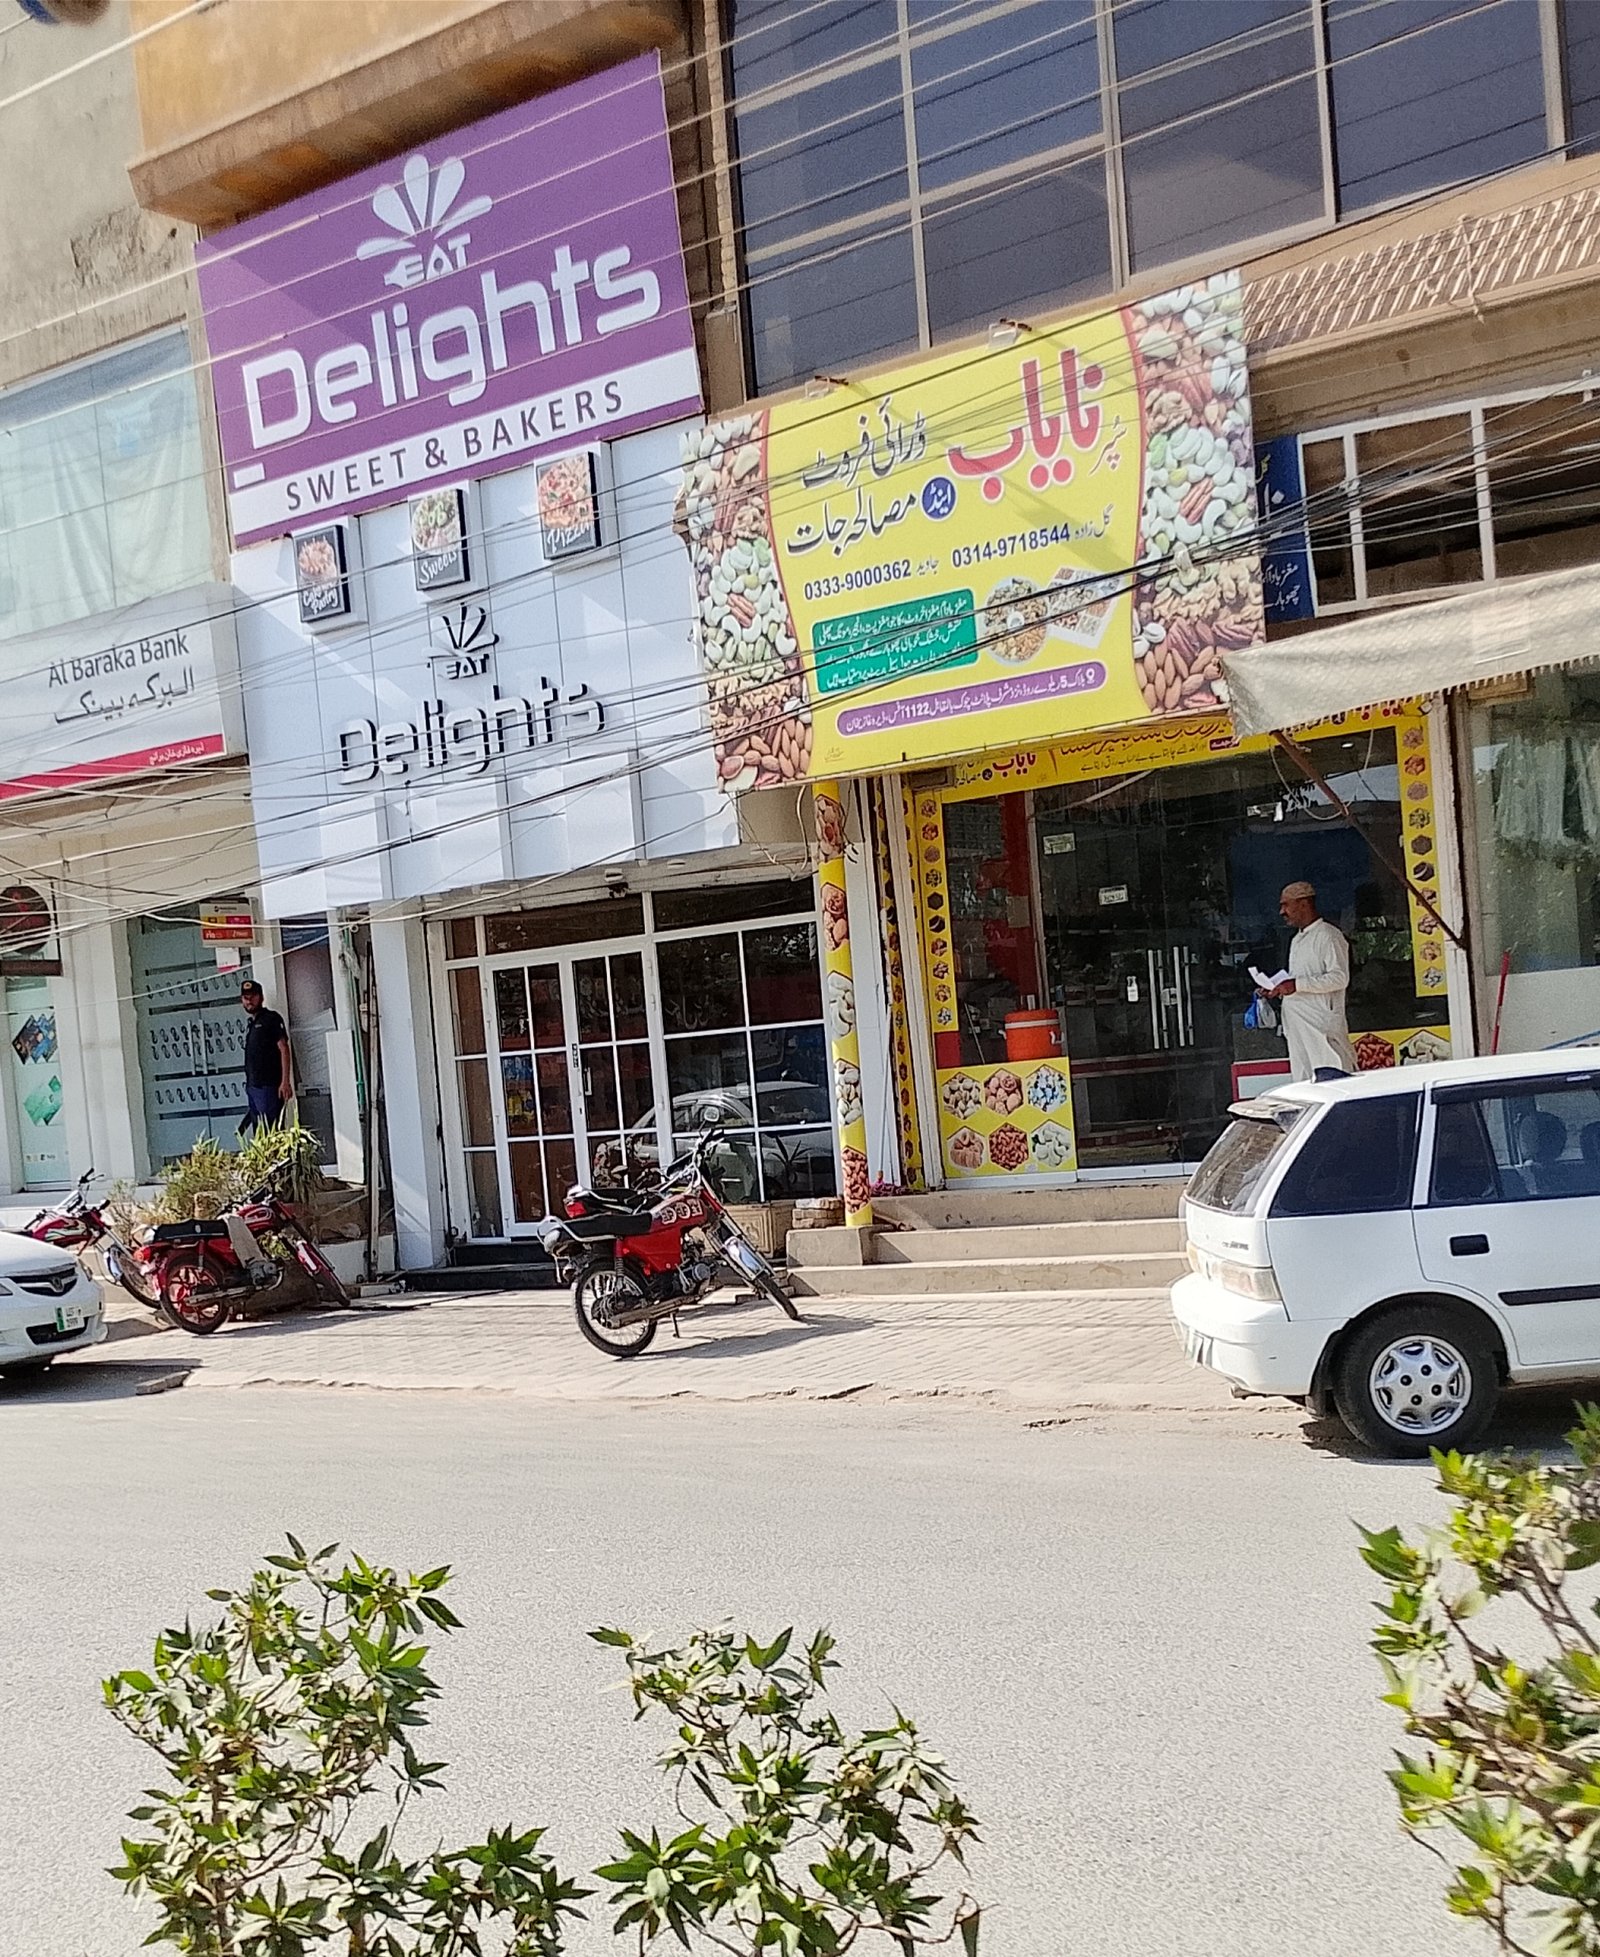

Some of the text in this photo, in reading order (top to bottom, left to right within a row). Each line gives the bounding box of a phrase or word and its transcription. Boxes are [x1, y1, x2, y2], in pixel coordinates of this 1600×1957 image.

[388, 234, 471, 288] EAT
[242, 245, 661, 449] Delights
[287, 380, 623, 511] SWEET & BAKERS
[803, 415, 870, 488] فروٹ
[948, 348, 1103, 501] نایاب
[952, 522, 1070, 568] 0314-9718544
[804, 559, 912, 601] 0333-9000362
[49, 630, 190, 688] Al Baraka Bank
[1060, 675, 1067, 689] 5
[339, 676, 605, 785] Delights
[905, 702, 930, 719] 1122
[992, 752, 1036, 778] نایاب
